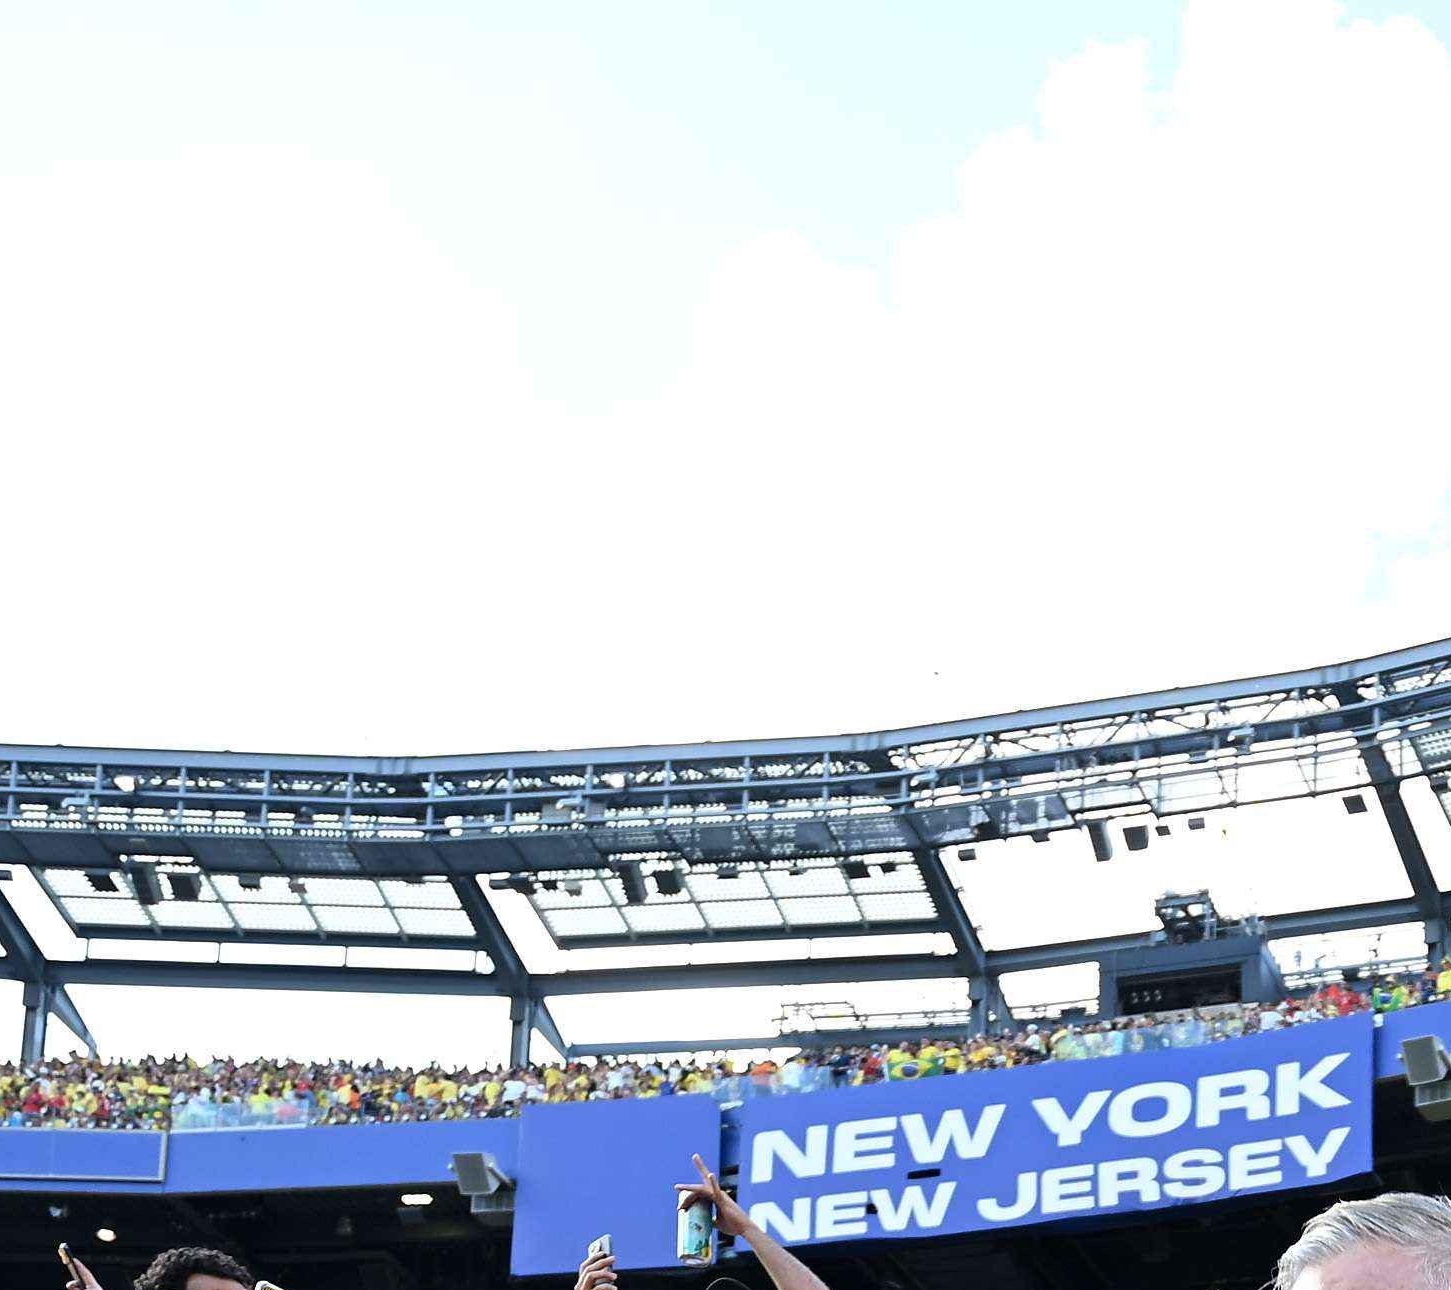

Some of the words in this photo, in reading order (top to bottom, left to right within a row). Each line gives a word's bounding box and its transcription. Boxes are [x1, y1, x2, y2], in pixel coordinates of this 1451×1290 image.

[751, 1104, 1006, 1183] NEW
[1032, 1053, 1351, 1146] YORK
[750, 1181, 956, 1242] NEW
[977, 1127, 1350, 1222] JERSEY
